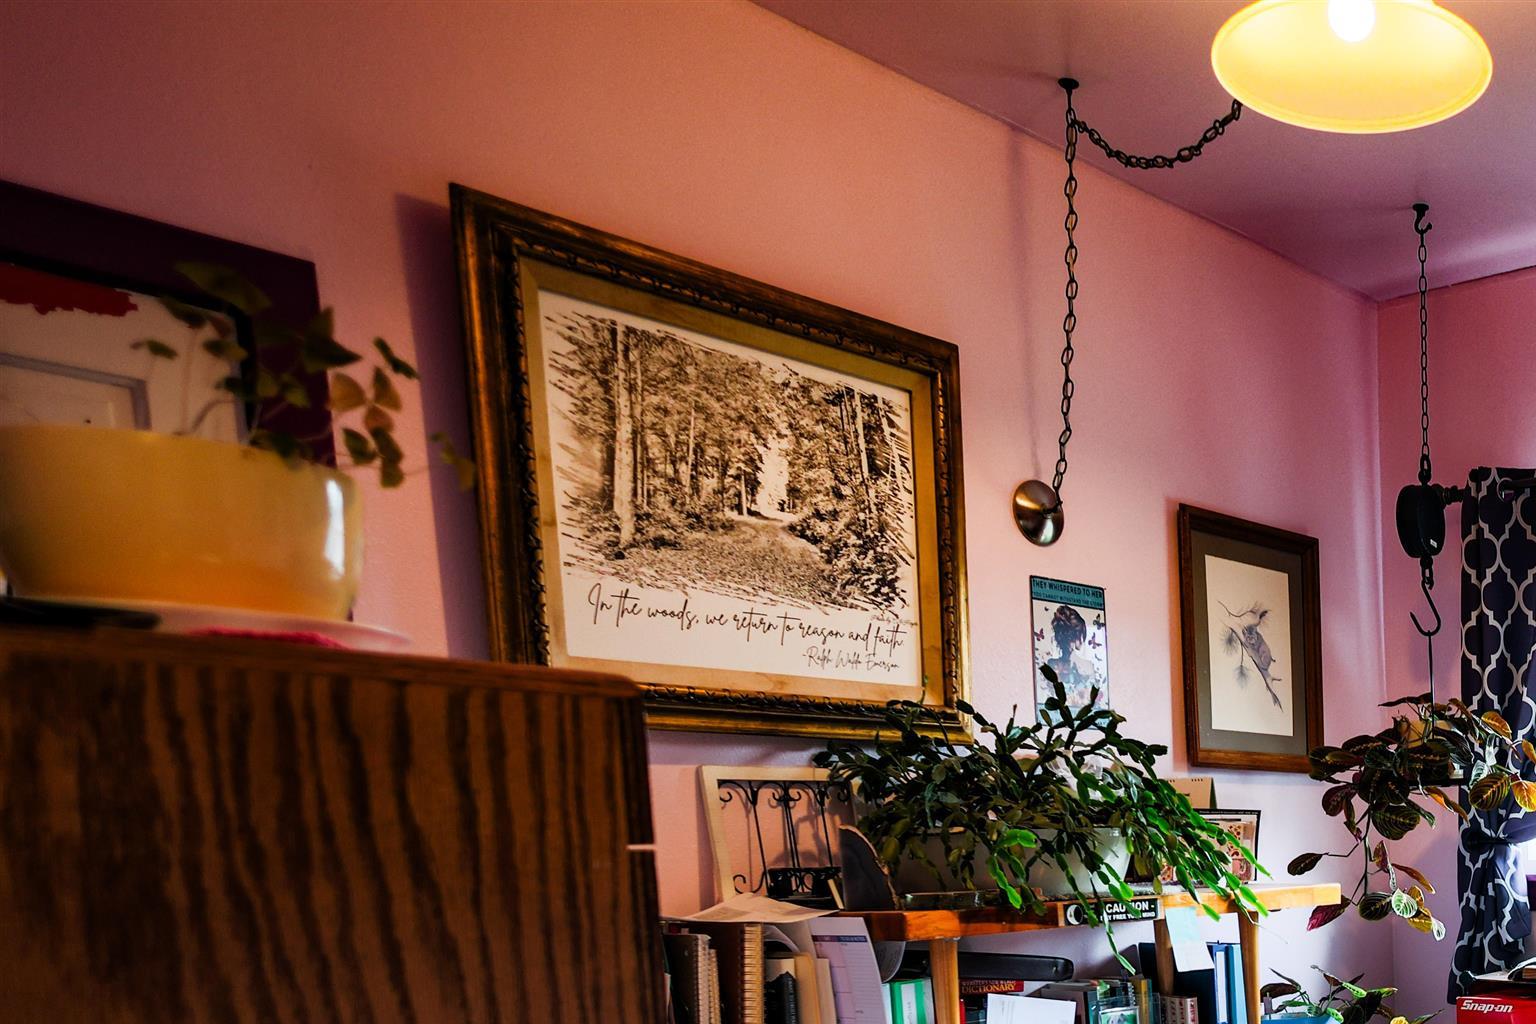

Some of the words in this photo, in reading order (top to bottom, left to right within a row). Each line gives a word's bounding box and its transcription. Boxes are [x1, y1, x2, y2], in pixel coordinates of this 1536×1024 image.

[1033, 579, 1048, 589] THEY
[1049, 582, 1082, 595] WHISPERED
[1082, 588, 1090, 597] TO
[588, 583, 611, 624] In
[611, 588, 642, 627] the
[706, 613, 728, 626] we
[733, 607, 778, 642] return
[777, 612, 800, 646] to
[799, 621, 845, 645] reason
[848, 623, 871, 651] and
[1105, 901, 1150, 913] CAUION
[961, 983, 1016, 993] DICTIONARY
[1461, 1000, 1513, 1013] Snap-on
